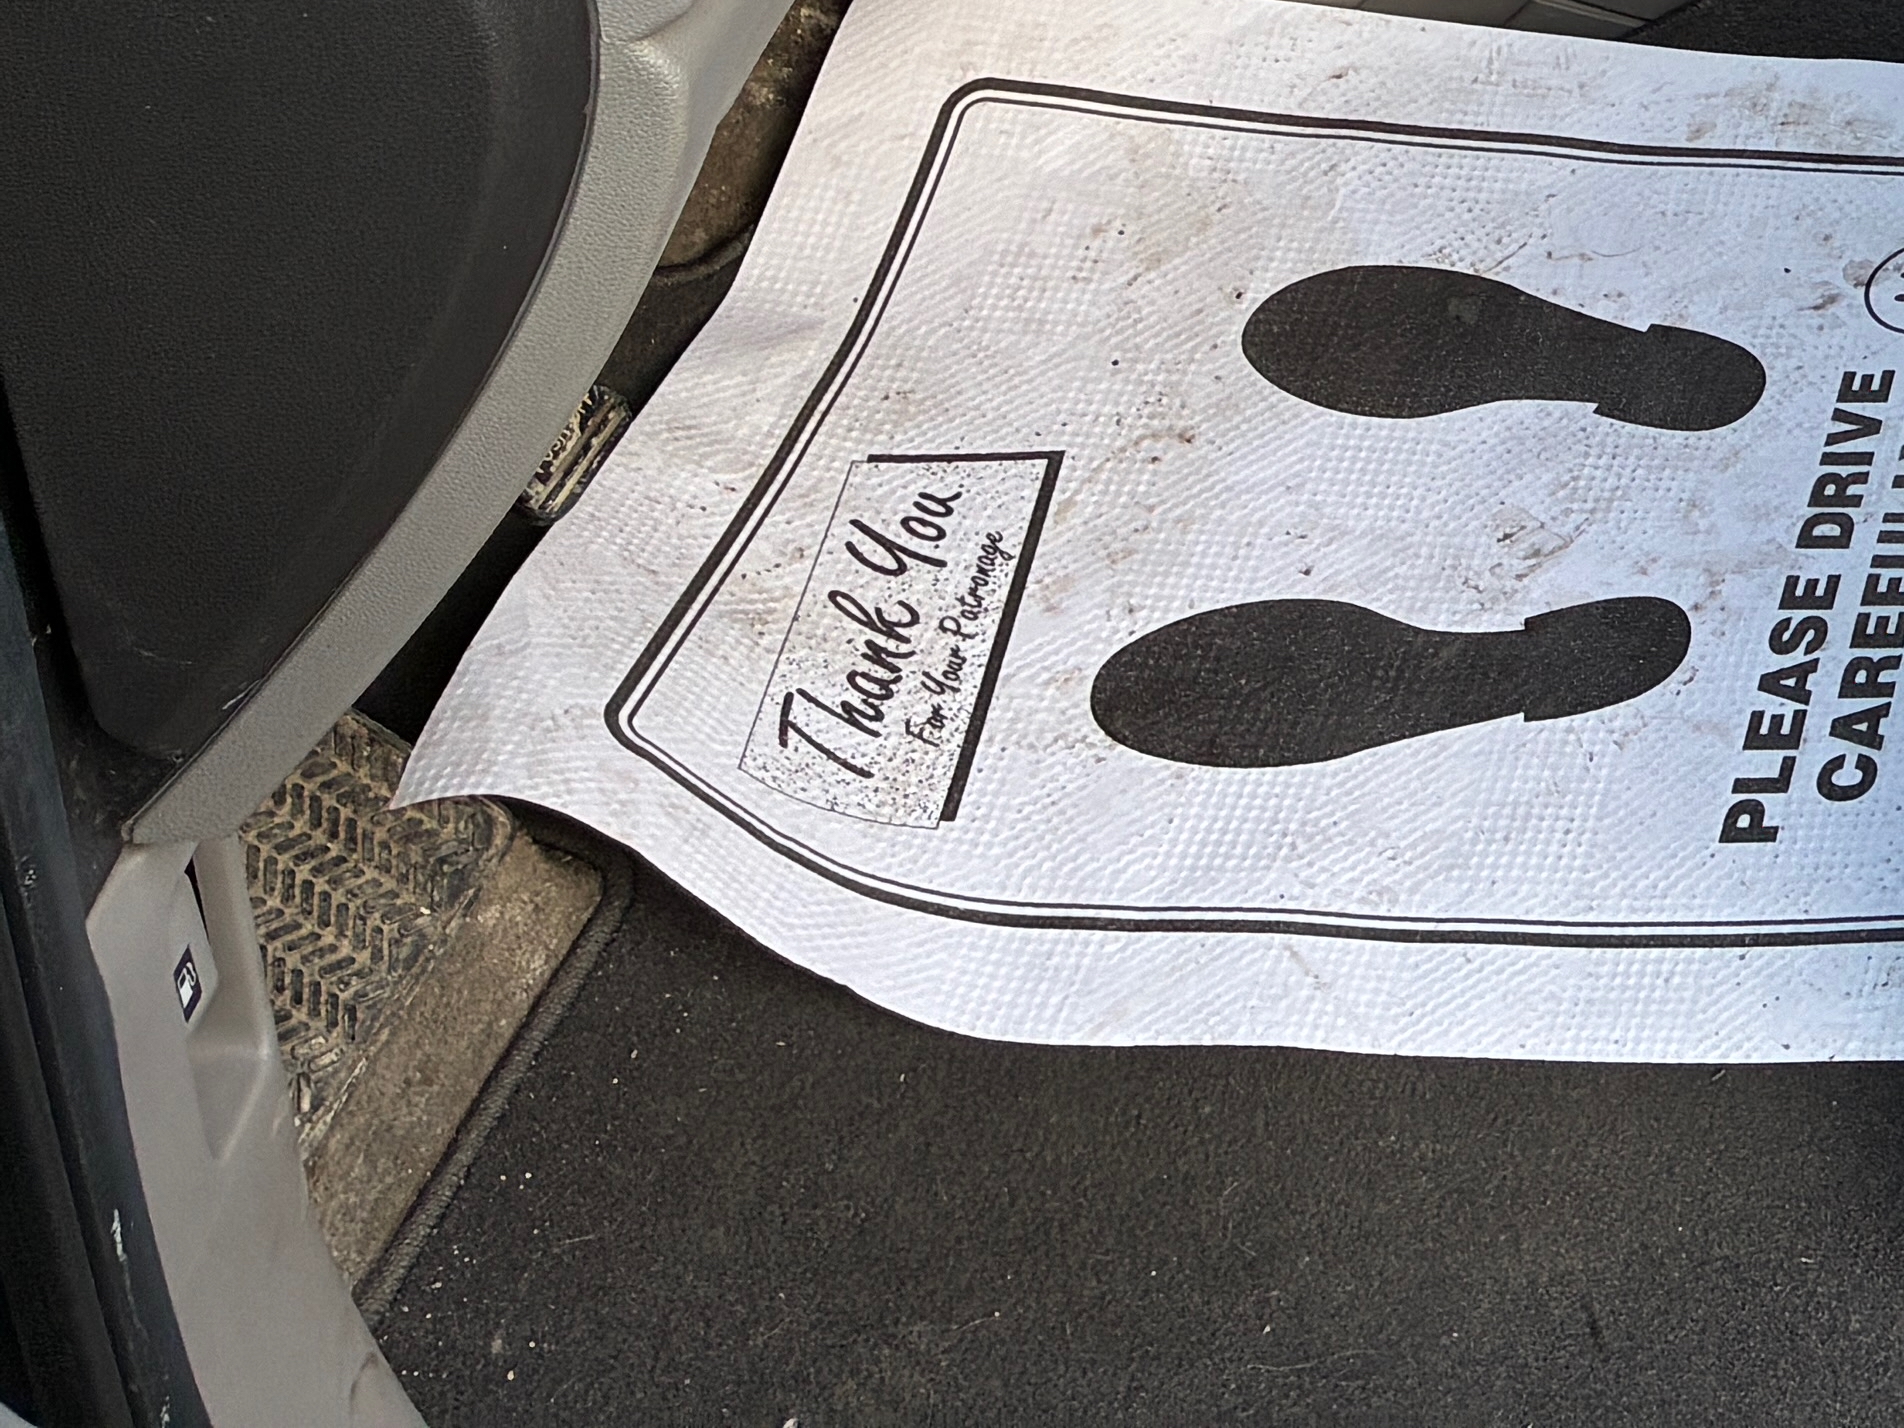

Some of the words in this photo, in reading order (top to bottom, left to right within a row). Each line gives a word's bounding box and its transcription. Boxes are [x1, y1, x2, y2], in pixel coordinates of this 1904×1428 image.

[844, 491, 963, 578] You
[938, 530, 1016, 642] Patronage
[1718, 573, 1842, 844] PLEASE
[1794, 369, 1896, 550] DRIVE
[778, 589, 920, 779] Thank
[921, 643, 968, 695] Your
[904, 702, 950, 748] For
